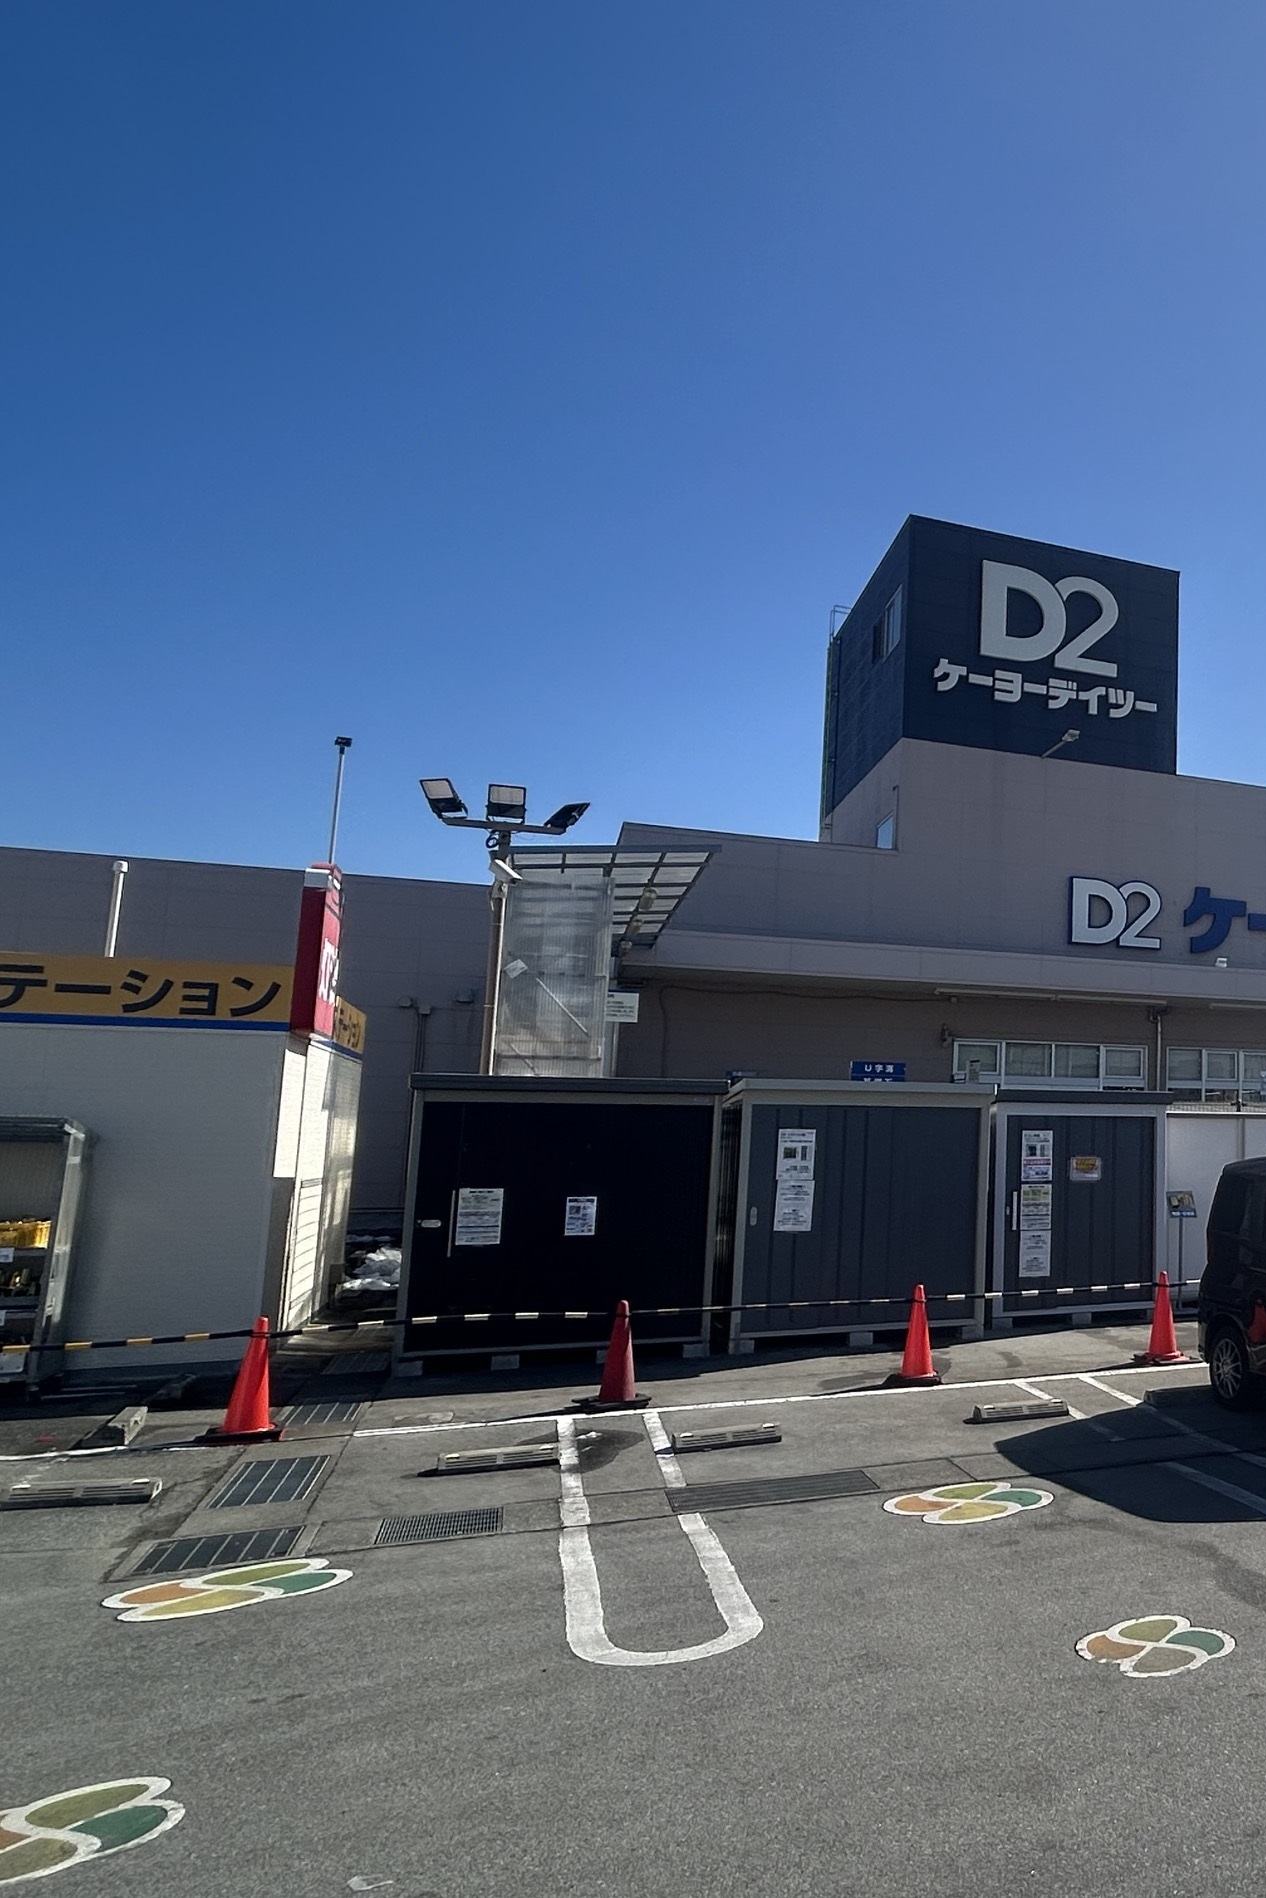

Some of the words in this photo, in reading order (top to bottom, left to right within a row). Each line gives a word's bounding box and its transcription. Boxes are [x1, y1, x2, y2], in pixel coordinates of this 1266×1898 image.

[979, 560, 1119, 678] D2
[934, 658, 1158, 718] ケーヨーデイツー
[1072, 877, 1161, 949] D2
[0, 963, 281, 1017] テーション
